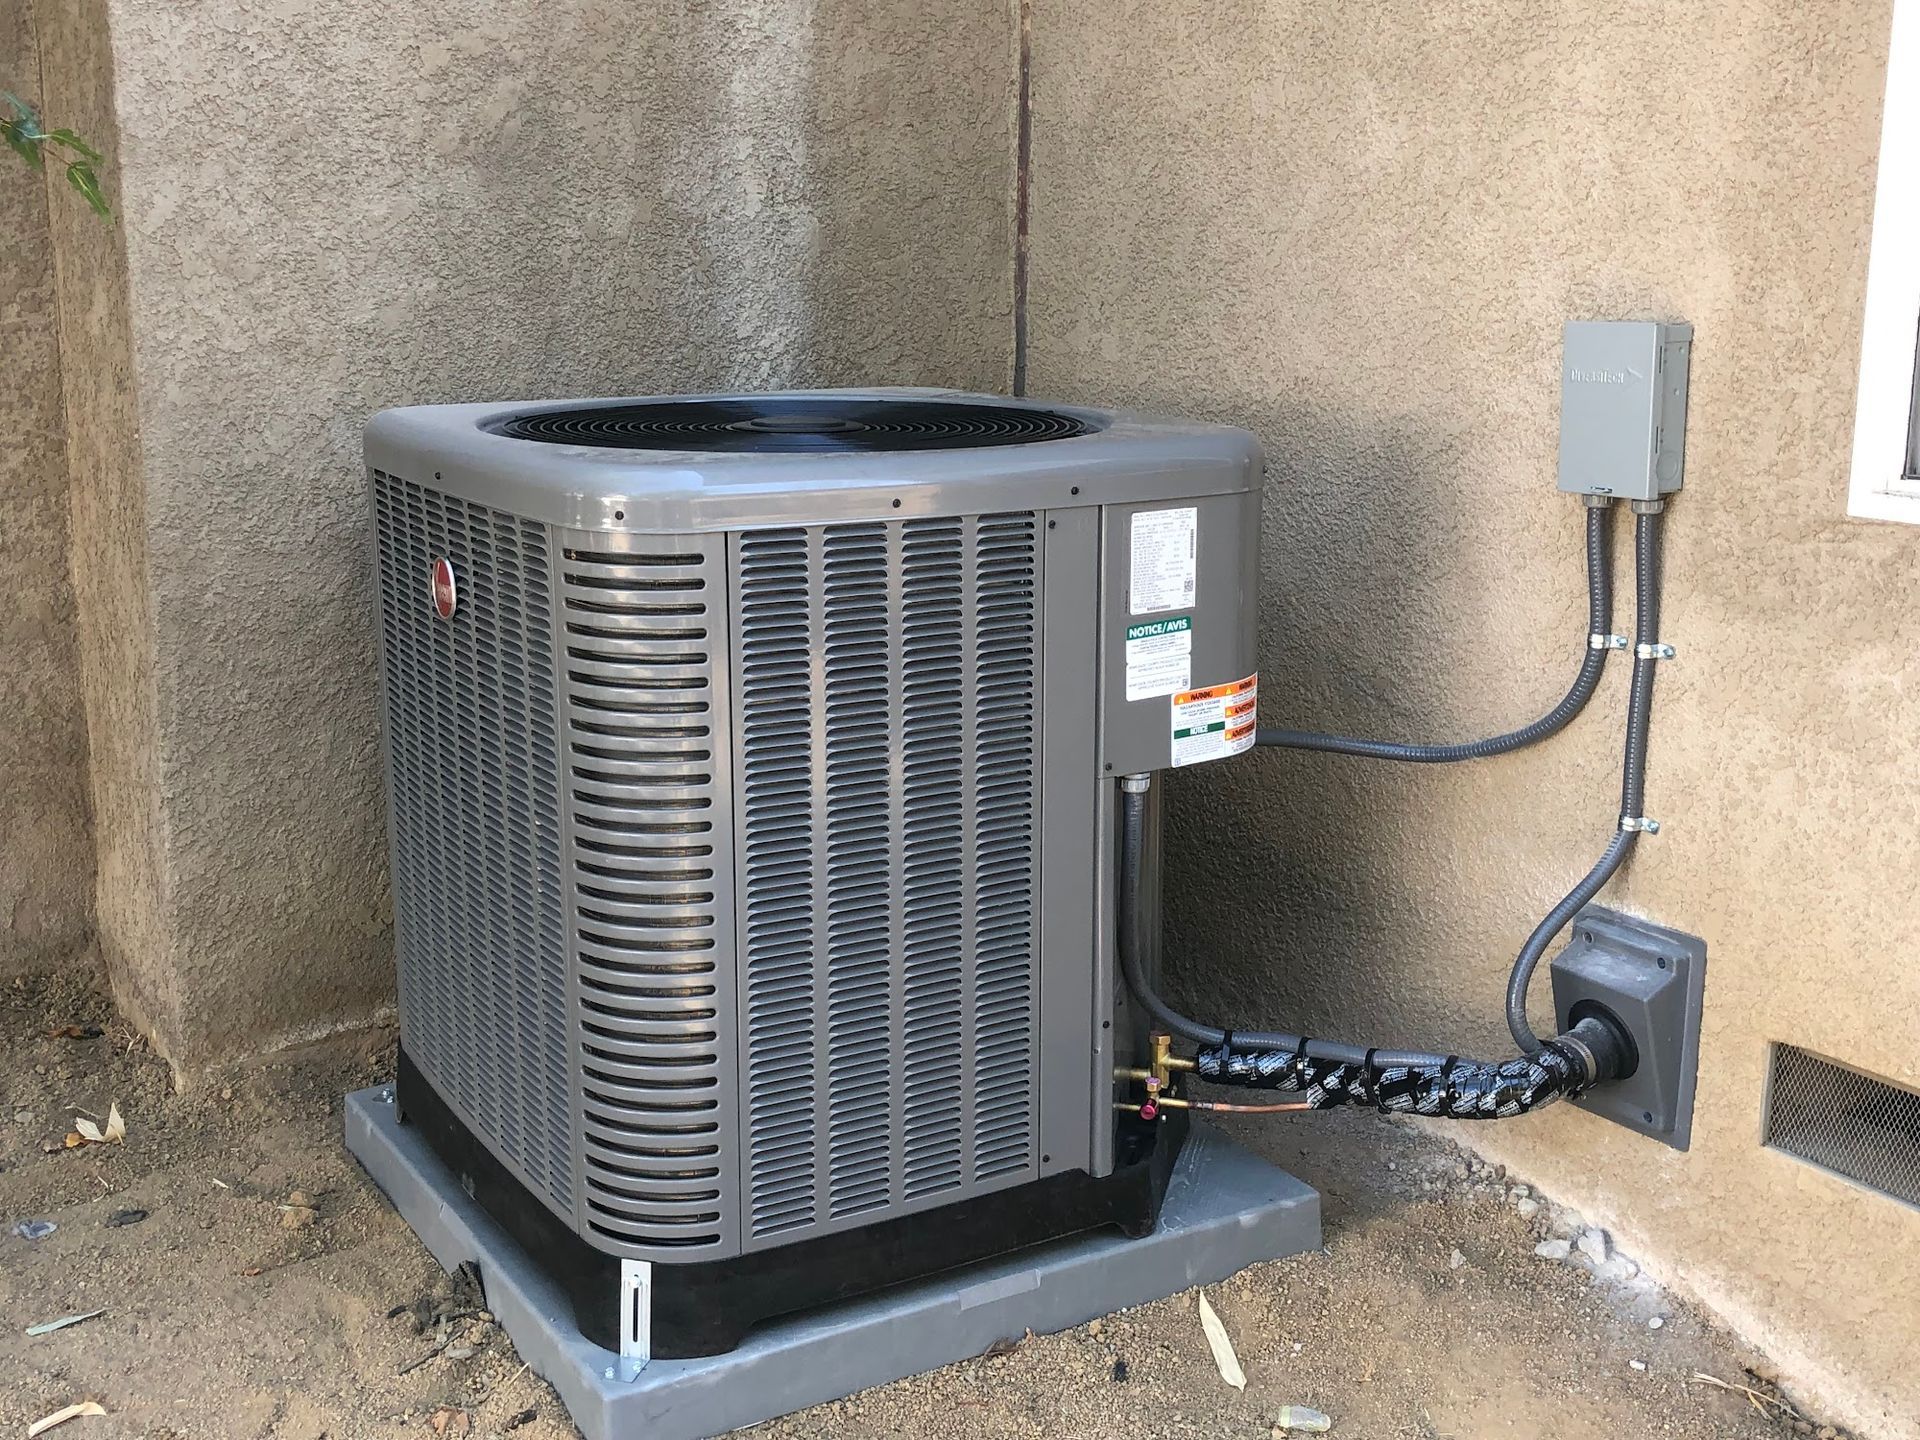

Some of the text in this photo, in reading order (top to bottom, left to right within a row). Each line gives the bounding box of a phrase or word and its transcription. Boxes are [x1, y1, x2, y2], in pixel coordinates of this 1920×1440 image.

[1128, 619, 1188, 639] NOTICE/AVIS
[1190, 690, 1213, 701] WARNING
[1190, 724, 1208, 736] NOTICE
